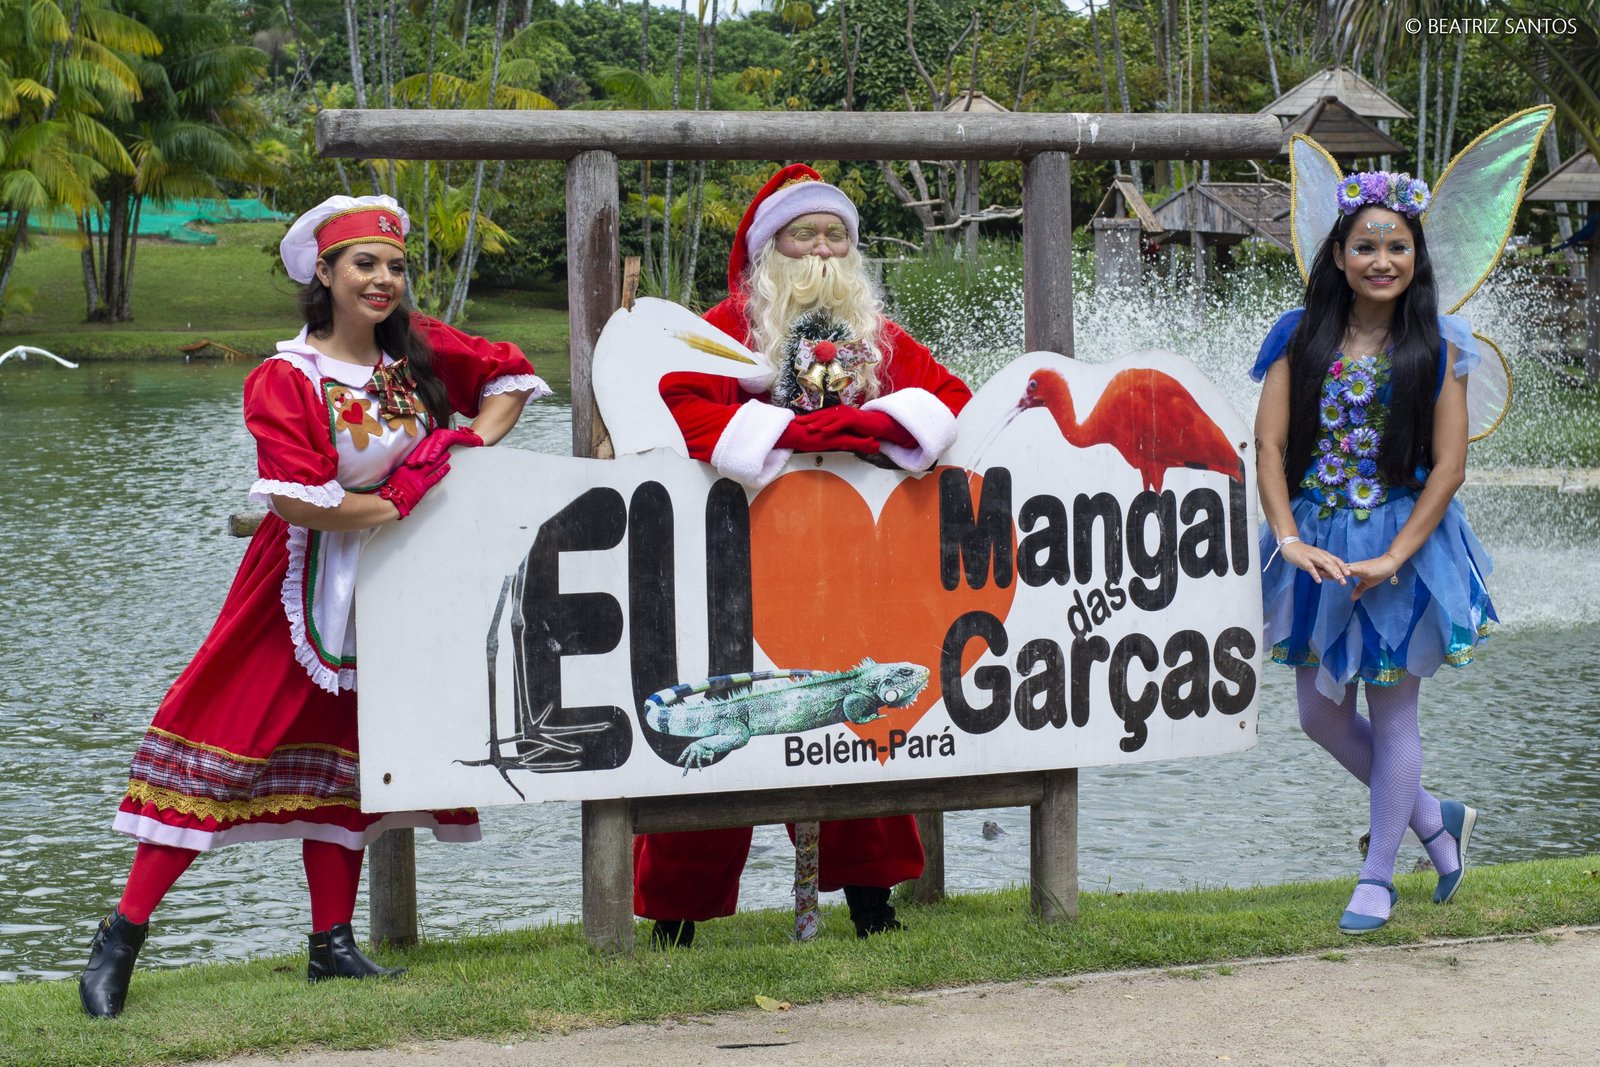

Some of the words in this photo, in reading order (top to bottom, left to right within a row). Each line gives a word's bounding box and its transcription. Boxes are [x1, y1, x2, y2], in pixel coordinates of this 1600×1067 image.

[939, 456, 1249, 612] Mangal
[513, 477, 754, 774] EU
[1067, 576, 1126, 637] das
[784, 725, 956, 767] Belém-Pará
[940, 610, 1257, 753] Garças
